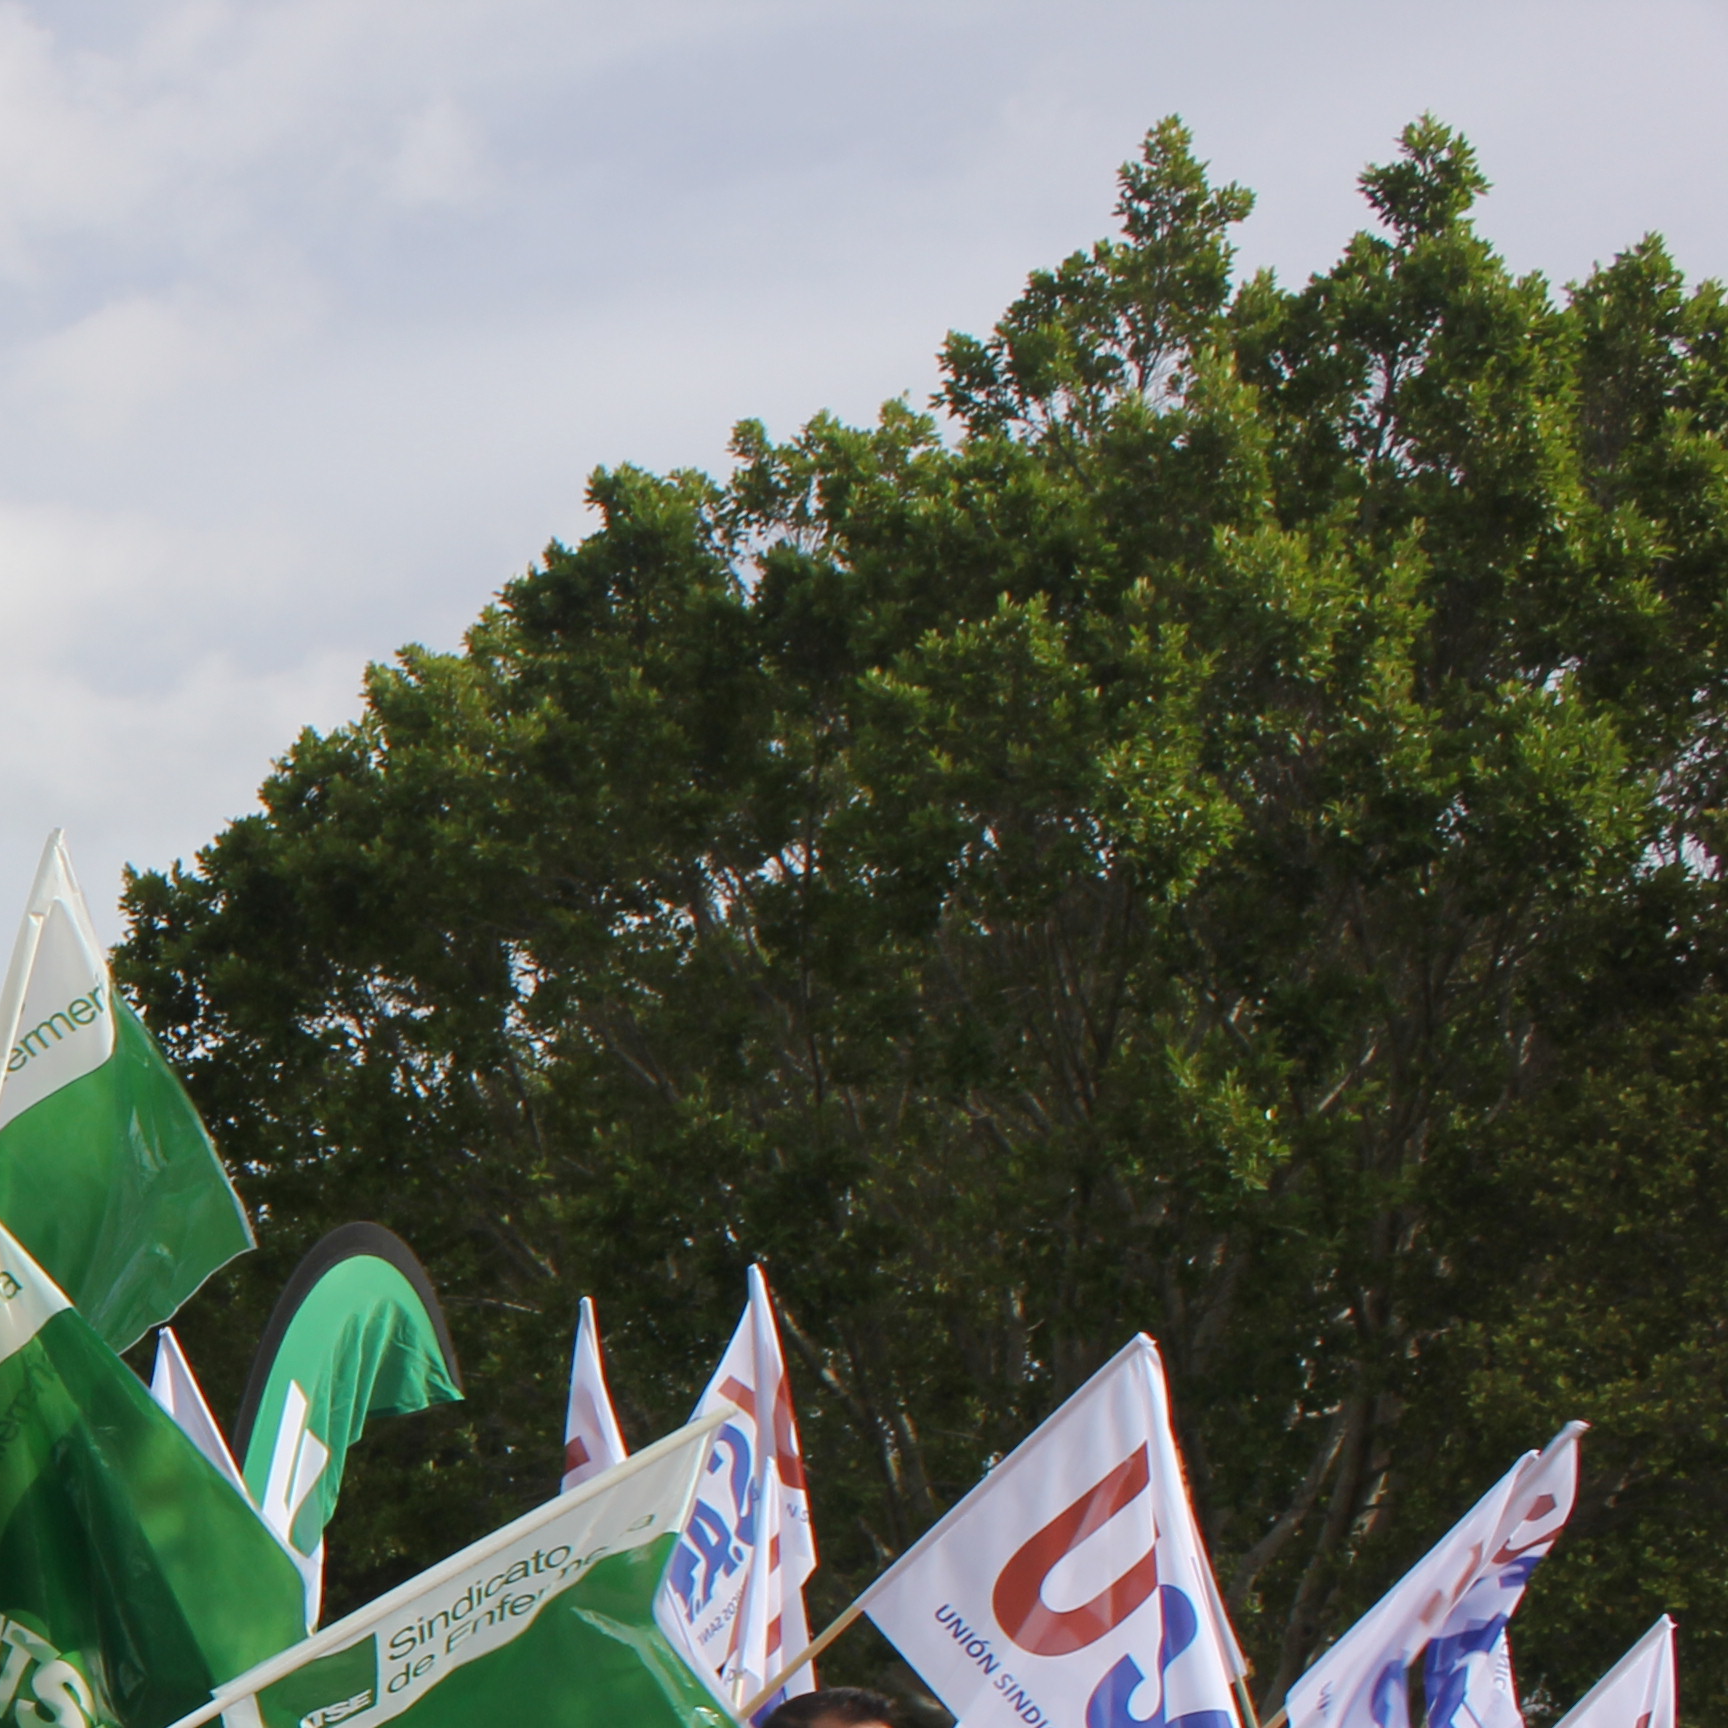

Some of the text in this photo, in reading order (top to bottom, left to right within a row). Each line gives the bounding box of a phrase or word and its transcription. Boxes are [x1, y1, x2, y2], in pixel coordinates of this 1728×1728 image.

[387, 1544, 572, 1662] Sindicato
[934, 1602, 1001, 1676] UNIÓN
[386, 1653, 436, 1695] de
